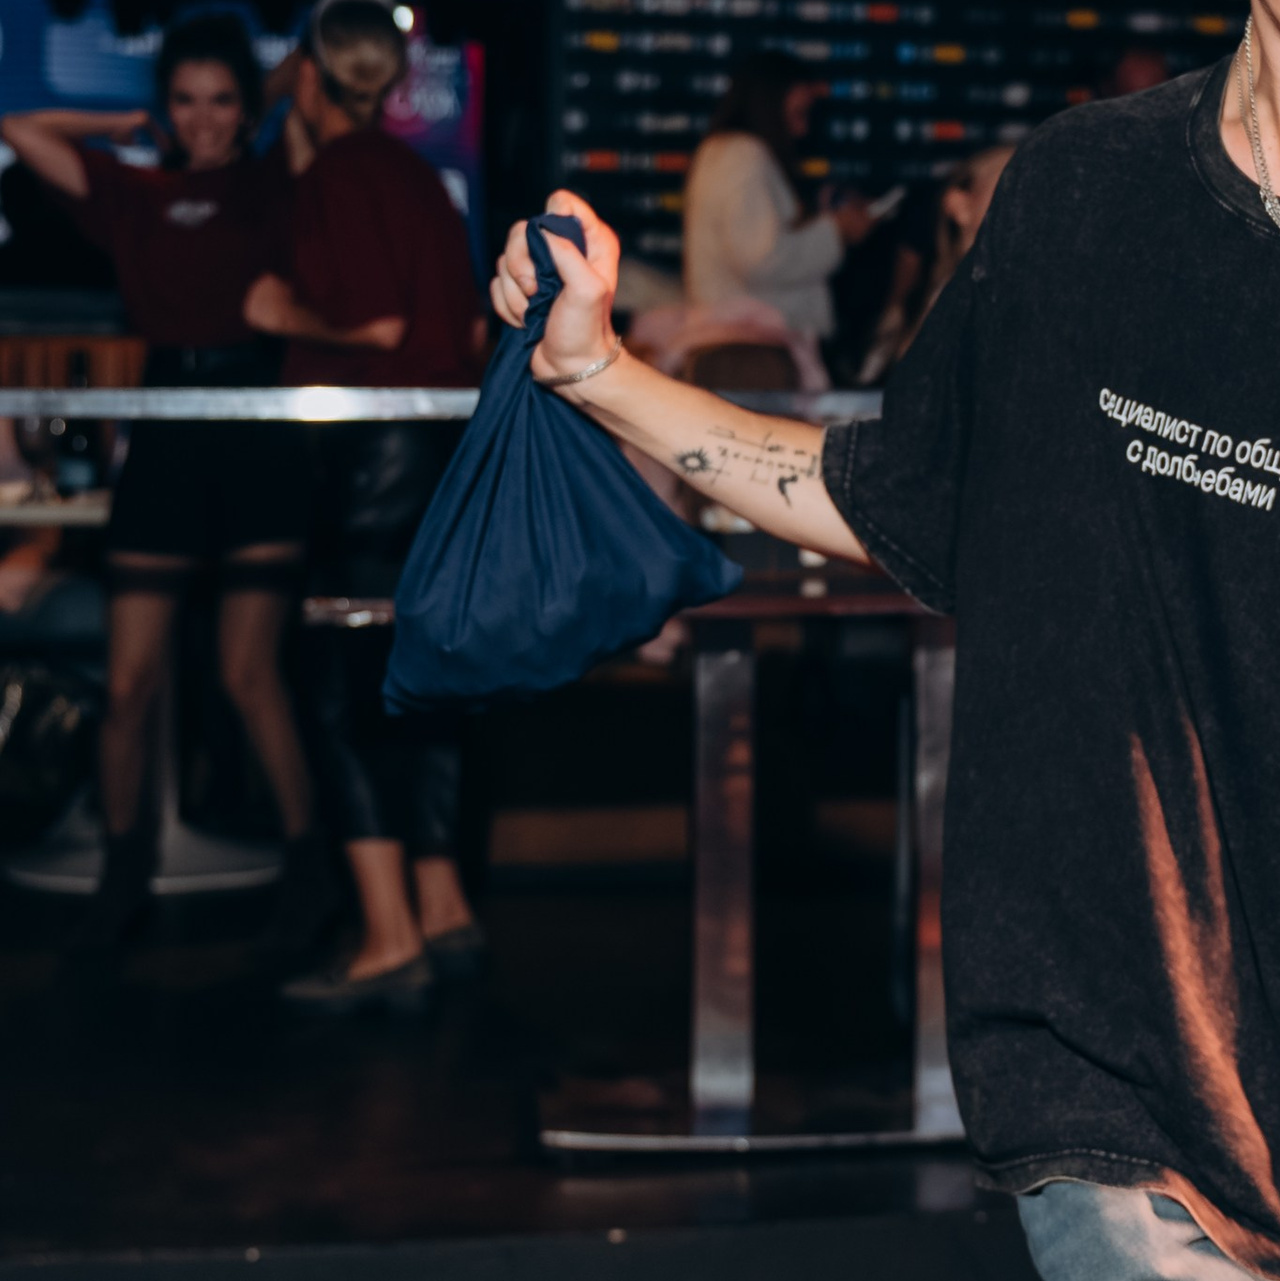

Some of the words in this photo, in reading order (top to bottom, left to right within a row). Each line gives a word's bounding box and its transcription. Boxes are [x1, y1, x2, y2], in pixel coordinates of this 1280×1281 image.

[1201, 429, 1232, 459] по
[1126, 439, 1143, 463] с
[1142, 446, 1276, 511] долбебами
